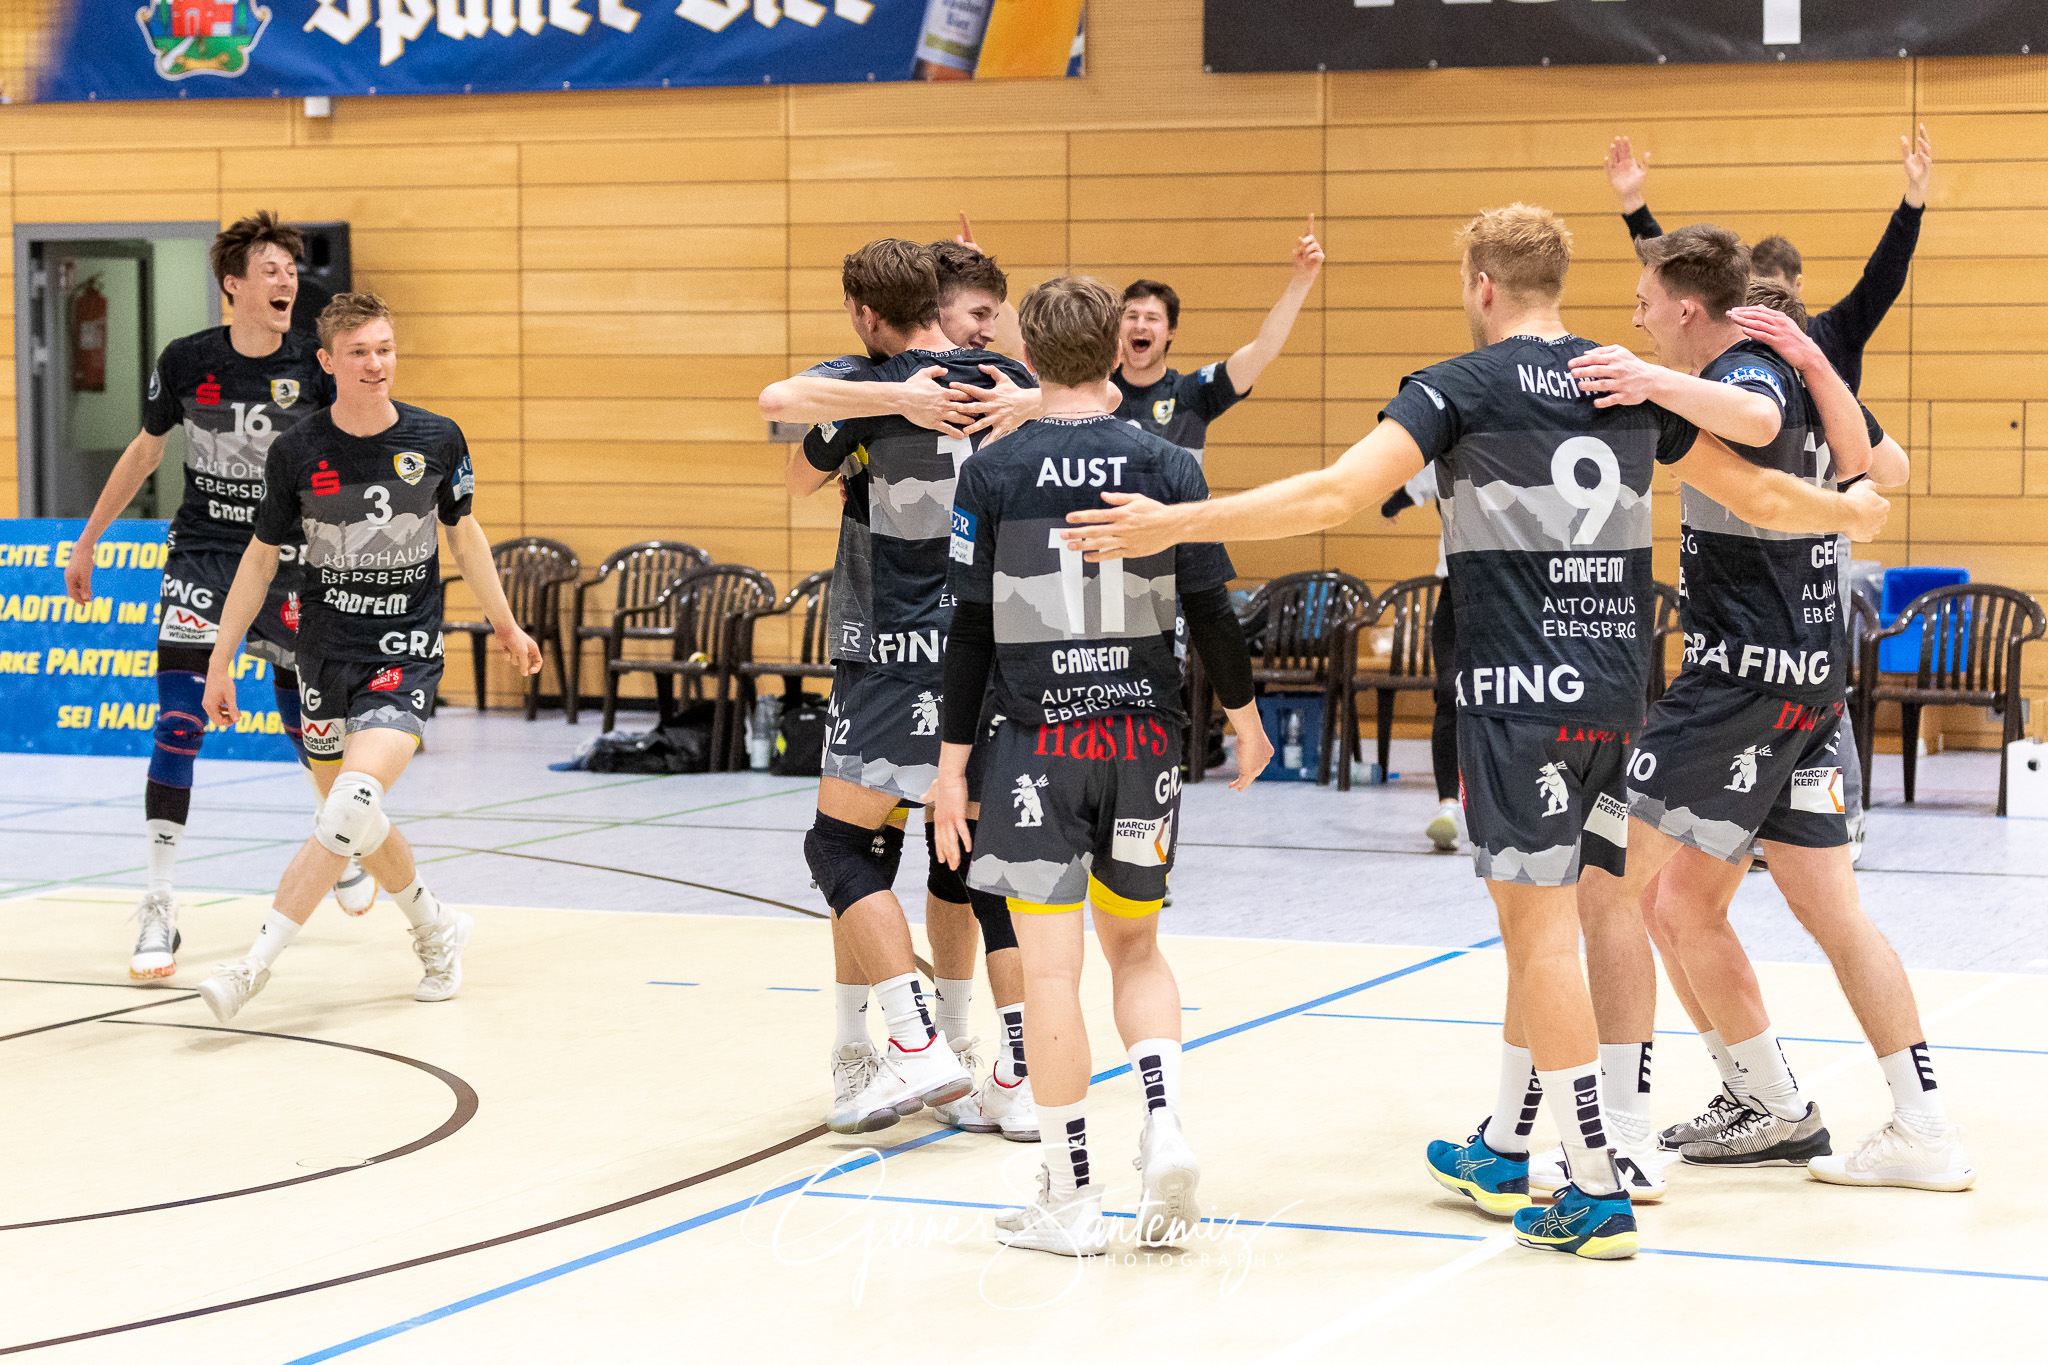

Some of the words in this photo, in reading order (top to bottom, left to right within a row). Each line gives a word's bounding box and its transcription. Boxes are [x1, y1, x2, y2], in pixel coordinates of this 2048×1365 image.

[230, 402, 273, 438] 16
[195, 457, 265, 479] AUTOH
[1036, 457, 1127, 488] AUST
[195, 476, 263, 499] EBERSB
[1551, 436, 1621, 545] 9
[364, 485, 394, 525] 3
[324, 542, 428, 568] AUTOHAUS
[1048, 528, 1126, 635] 11
[1549, 556, 1624, 584] CADFEM
[117, 602, 147, 624] IM
[1543, 620, 1636, 639] EBERSBERG
[1052, 646, 1130, 675] CADFEM
[410, 689, 425, 710] 3
[1041, 678, 1152, 706] AUTOHAUS
[57, 706, 92, 729] SEI
[832, 718, 851, 745] 12
[1626, 747, 1657, 781] 10
[1596, 802, 1626, 821] KERTI
[1116, 821, 1156, 831] MARCUS
[1116, 829, 1146, 840] KERTI
